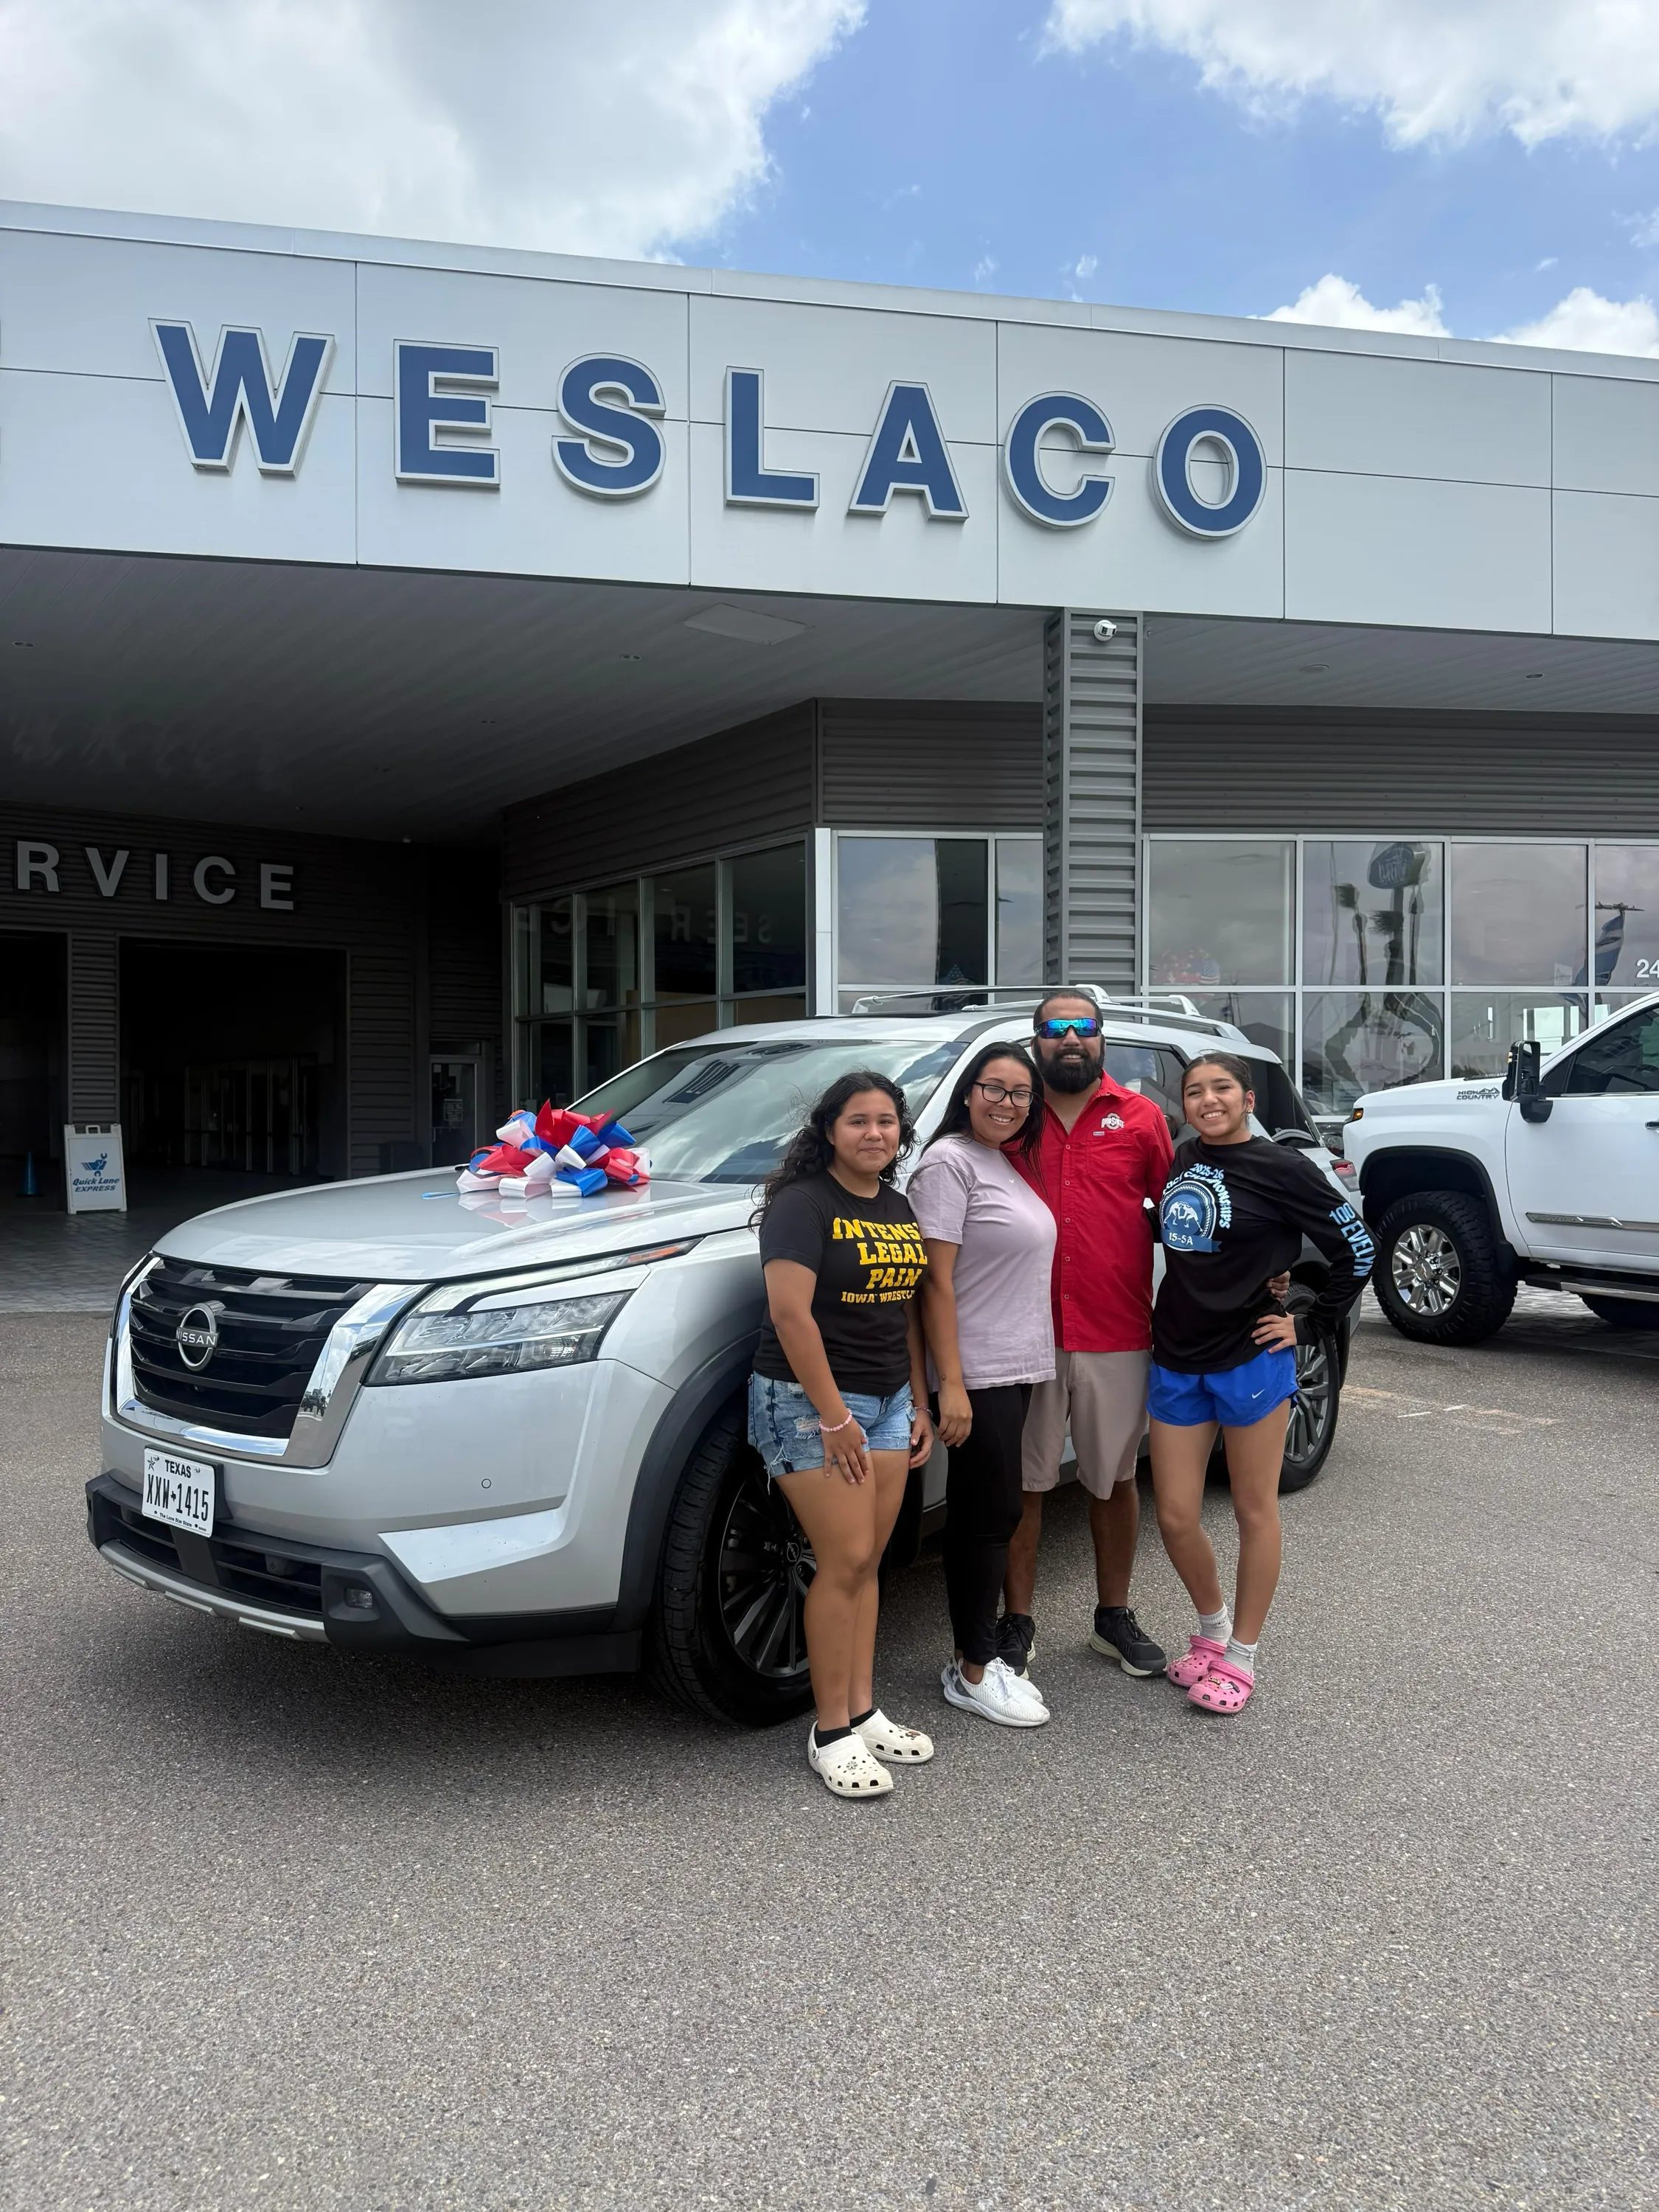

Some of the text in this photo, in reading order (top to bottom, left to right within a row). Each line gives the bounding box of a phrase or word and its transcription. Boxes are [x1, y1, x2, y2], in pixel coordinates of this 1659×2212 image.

[148, 318, 1267, 541] WESLACO
[16, 840, 294, 911] RVICE
[72, 1178, 97, 1186] Quick
[1189, 1163, 1224, 1180] 2025-26
[1329, 1202, 1355, 1225] 100
[857, 1242, 928, 1265] LEGAL
[1340, 1220, 1377, 1276] EVELYN
[865, 1267, 922, 1289] PAIN
[841, 1291, 876, 1304] IOWA
[175, 1329, 216, 1346] NISSAN
[164, 1459, 192, 1478] TEXAS
